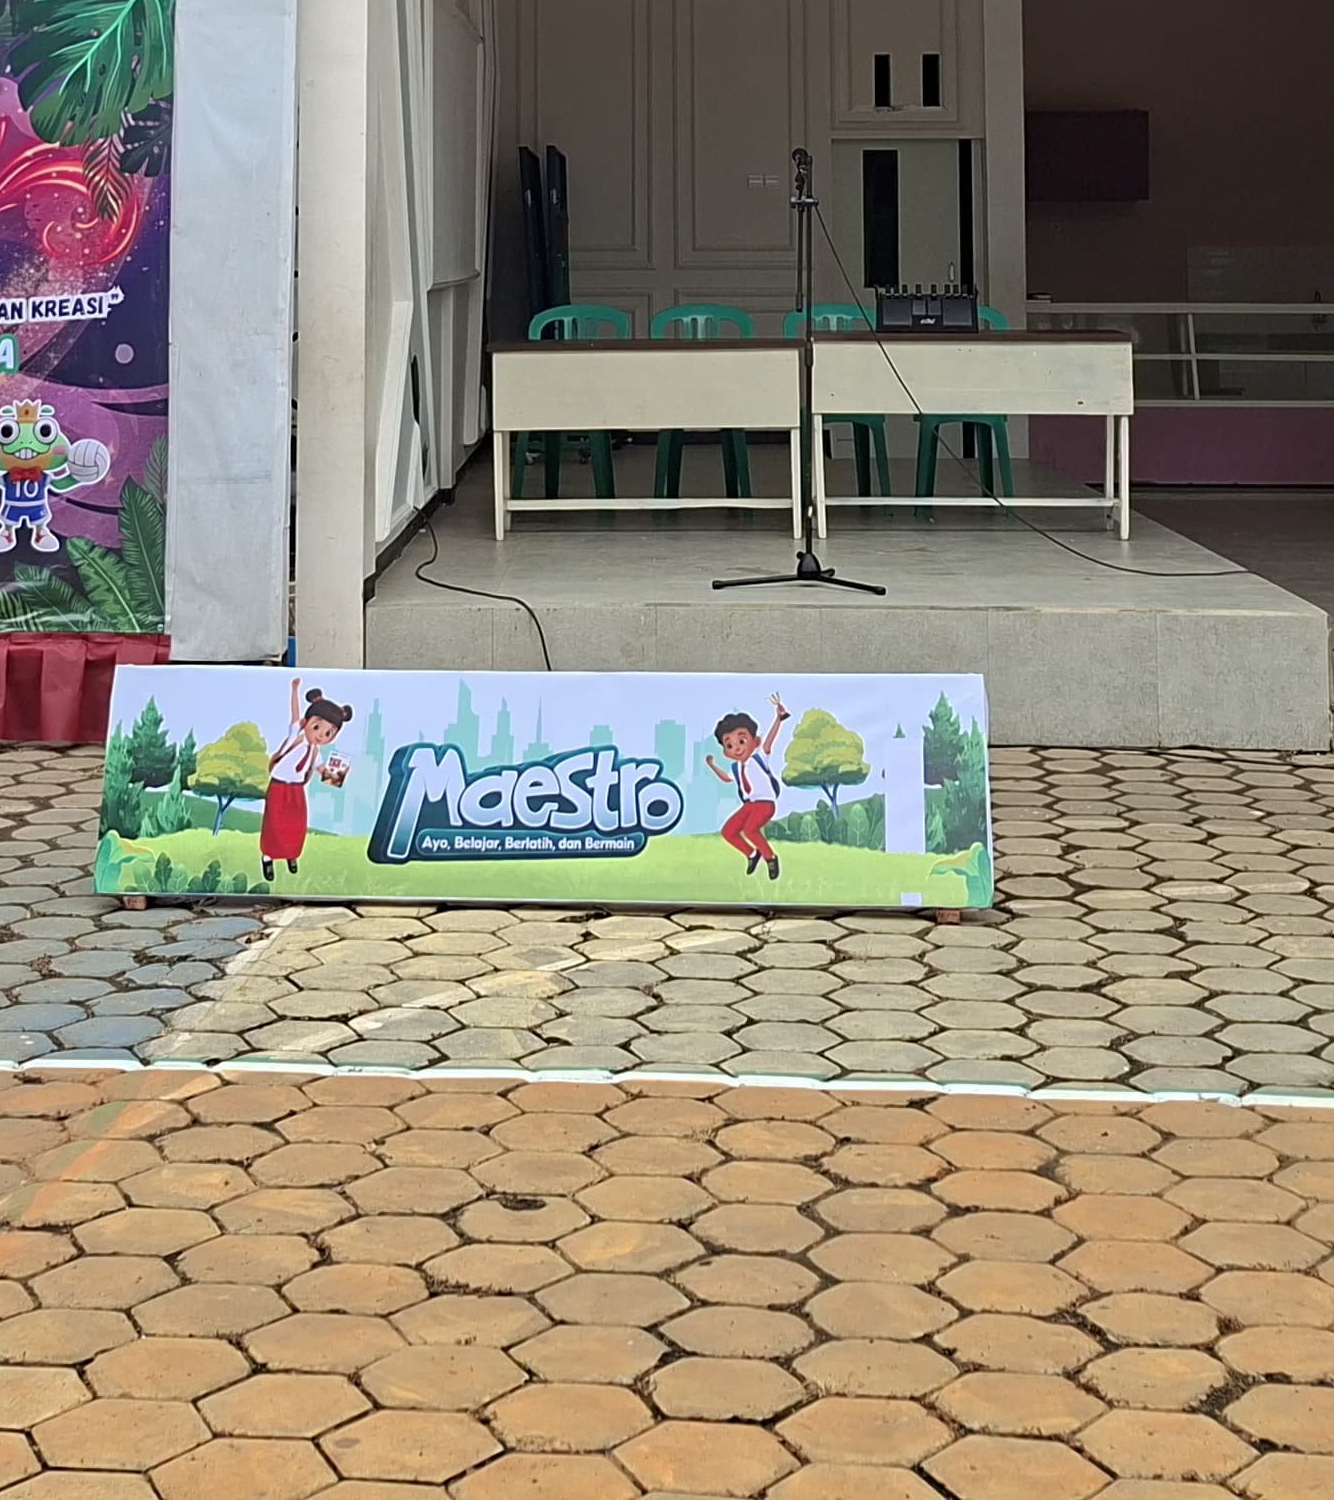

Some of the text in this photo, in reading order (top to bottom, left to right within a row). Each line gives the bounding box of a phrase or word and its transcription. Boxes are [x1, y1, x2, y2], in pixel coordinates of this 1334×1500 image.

[13, 480, 39, 498] 10
[387, 746, 682, 859] Maestro
[421, 835, 636, 853] Ayo, Belajar, Berlatih, dan Bermain
